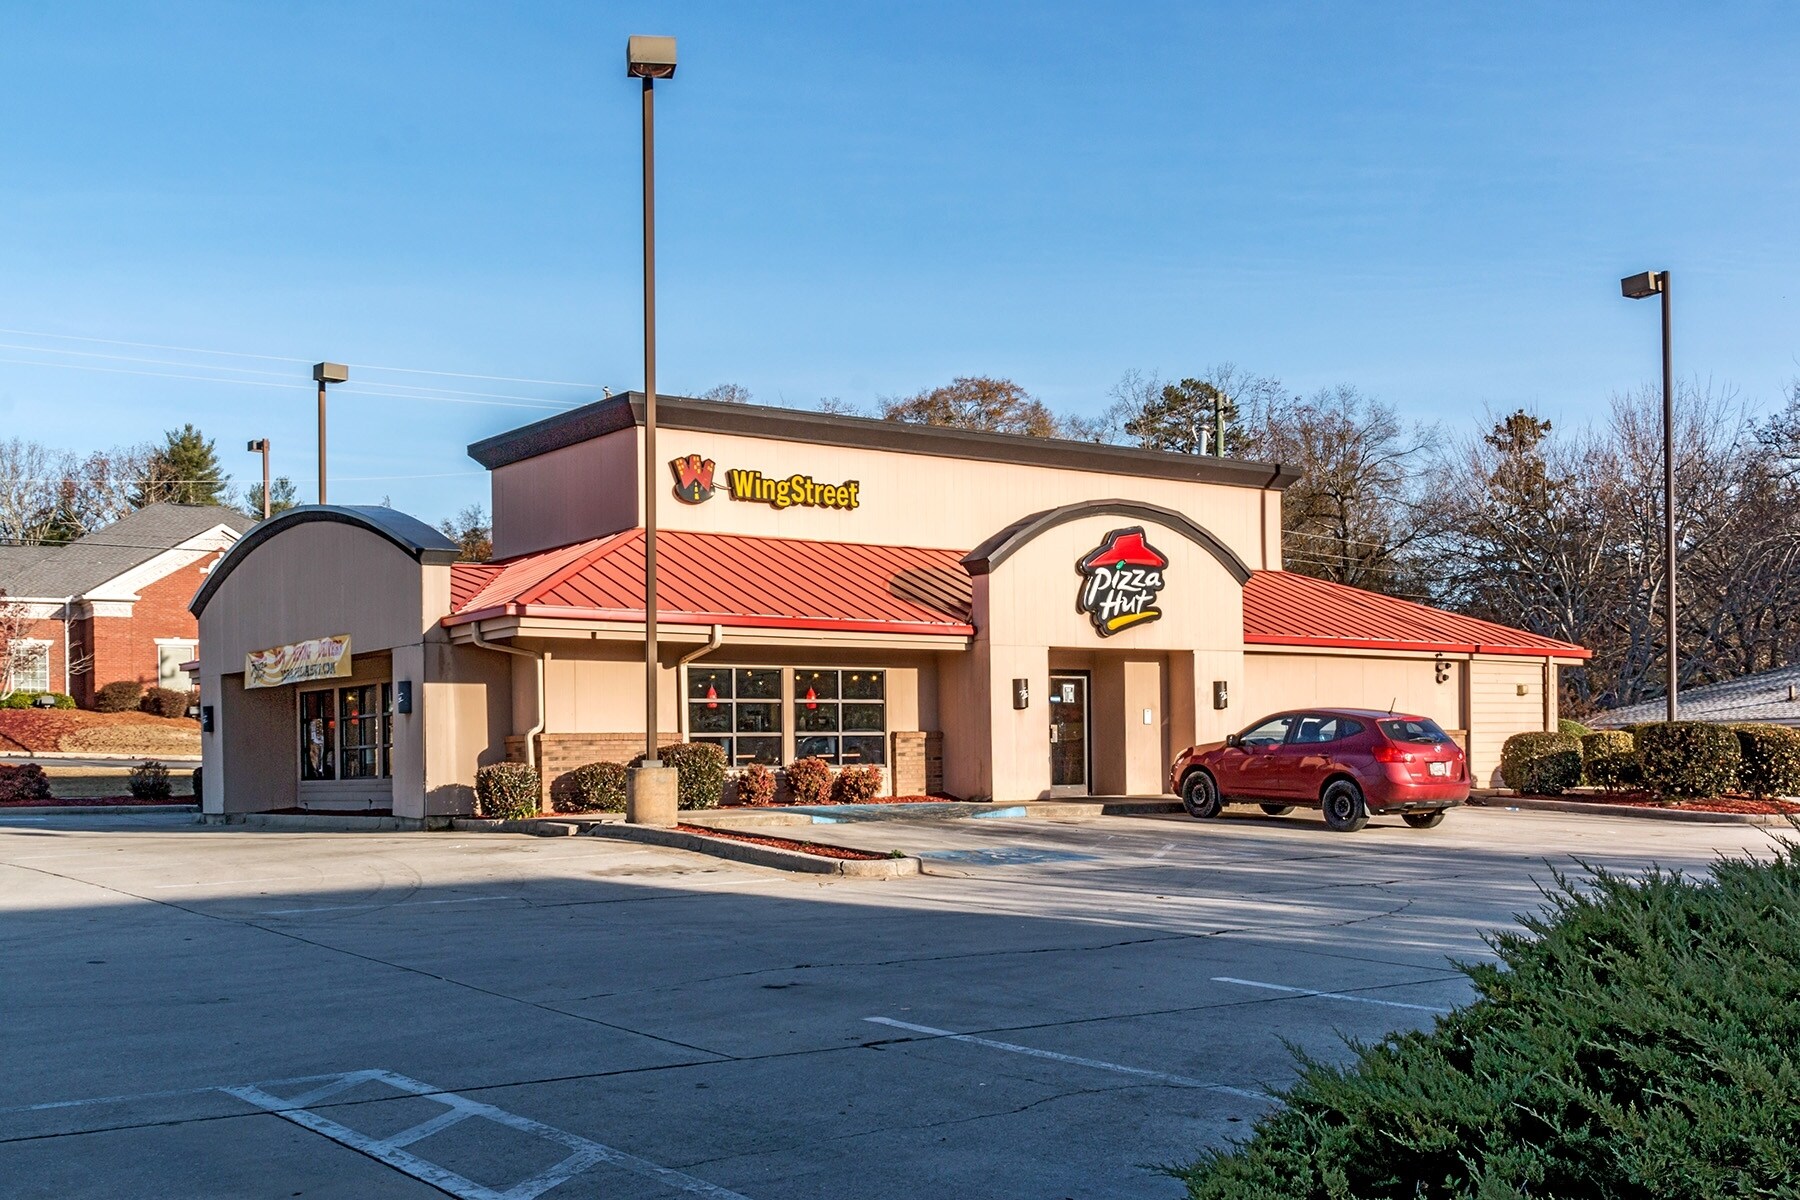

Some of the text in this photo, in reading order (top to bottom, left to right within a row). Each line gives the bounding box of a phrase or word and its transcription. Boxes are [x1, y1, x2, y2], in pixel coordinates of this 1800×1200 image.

[730, 469, 860, 508] WingStreet
[1087, 567, 1162, 606] Pizza
[1099, 588, 1154, 620] Hut
